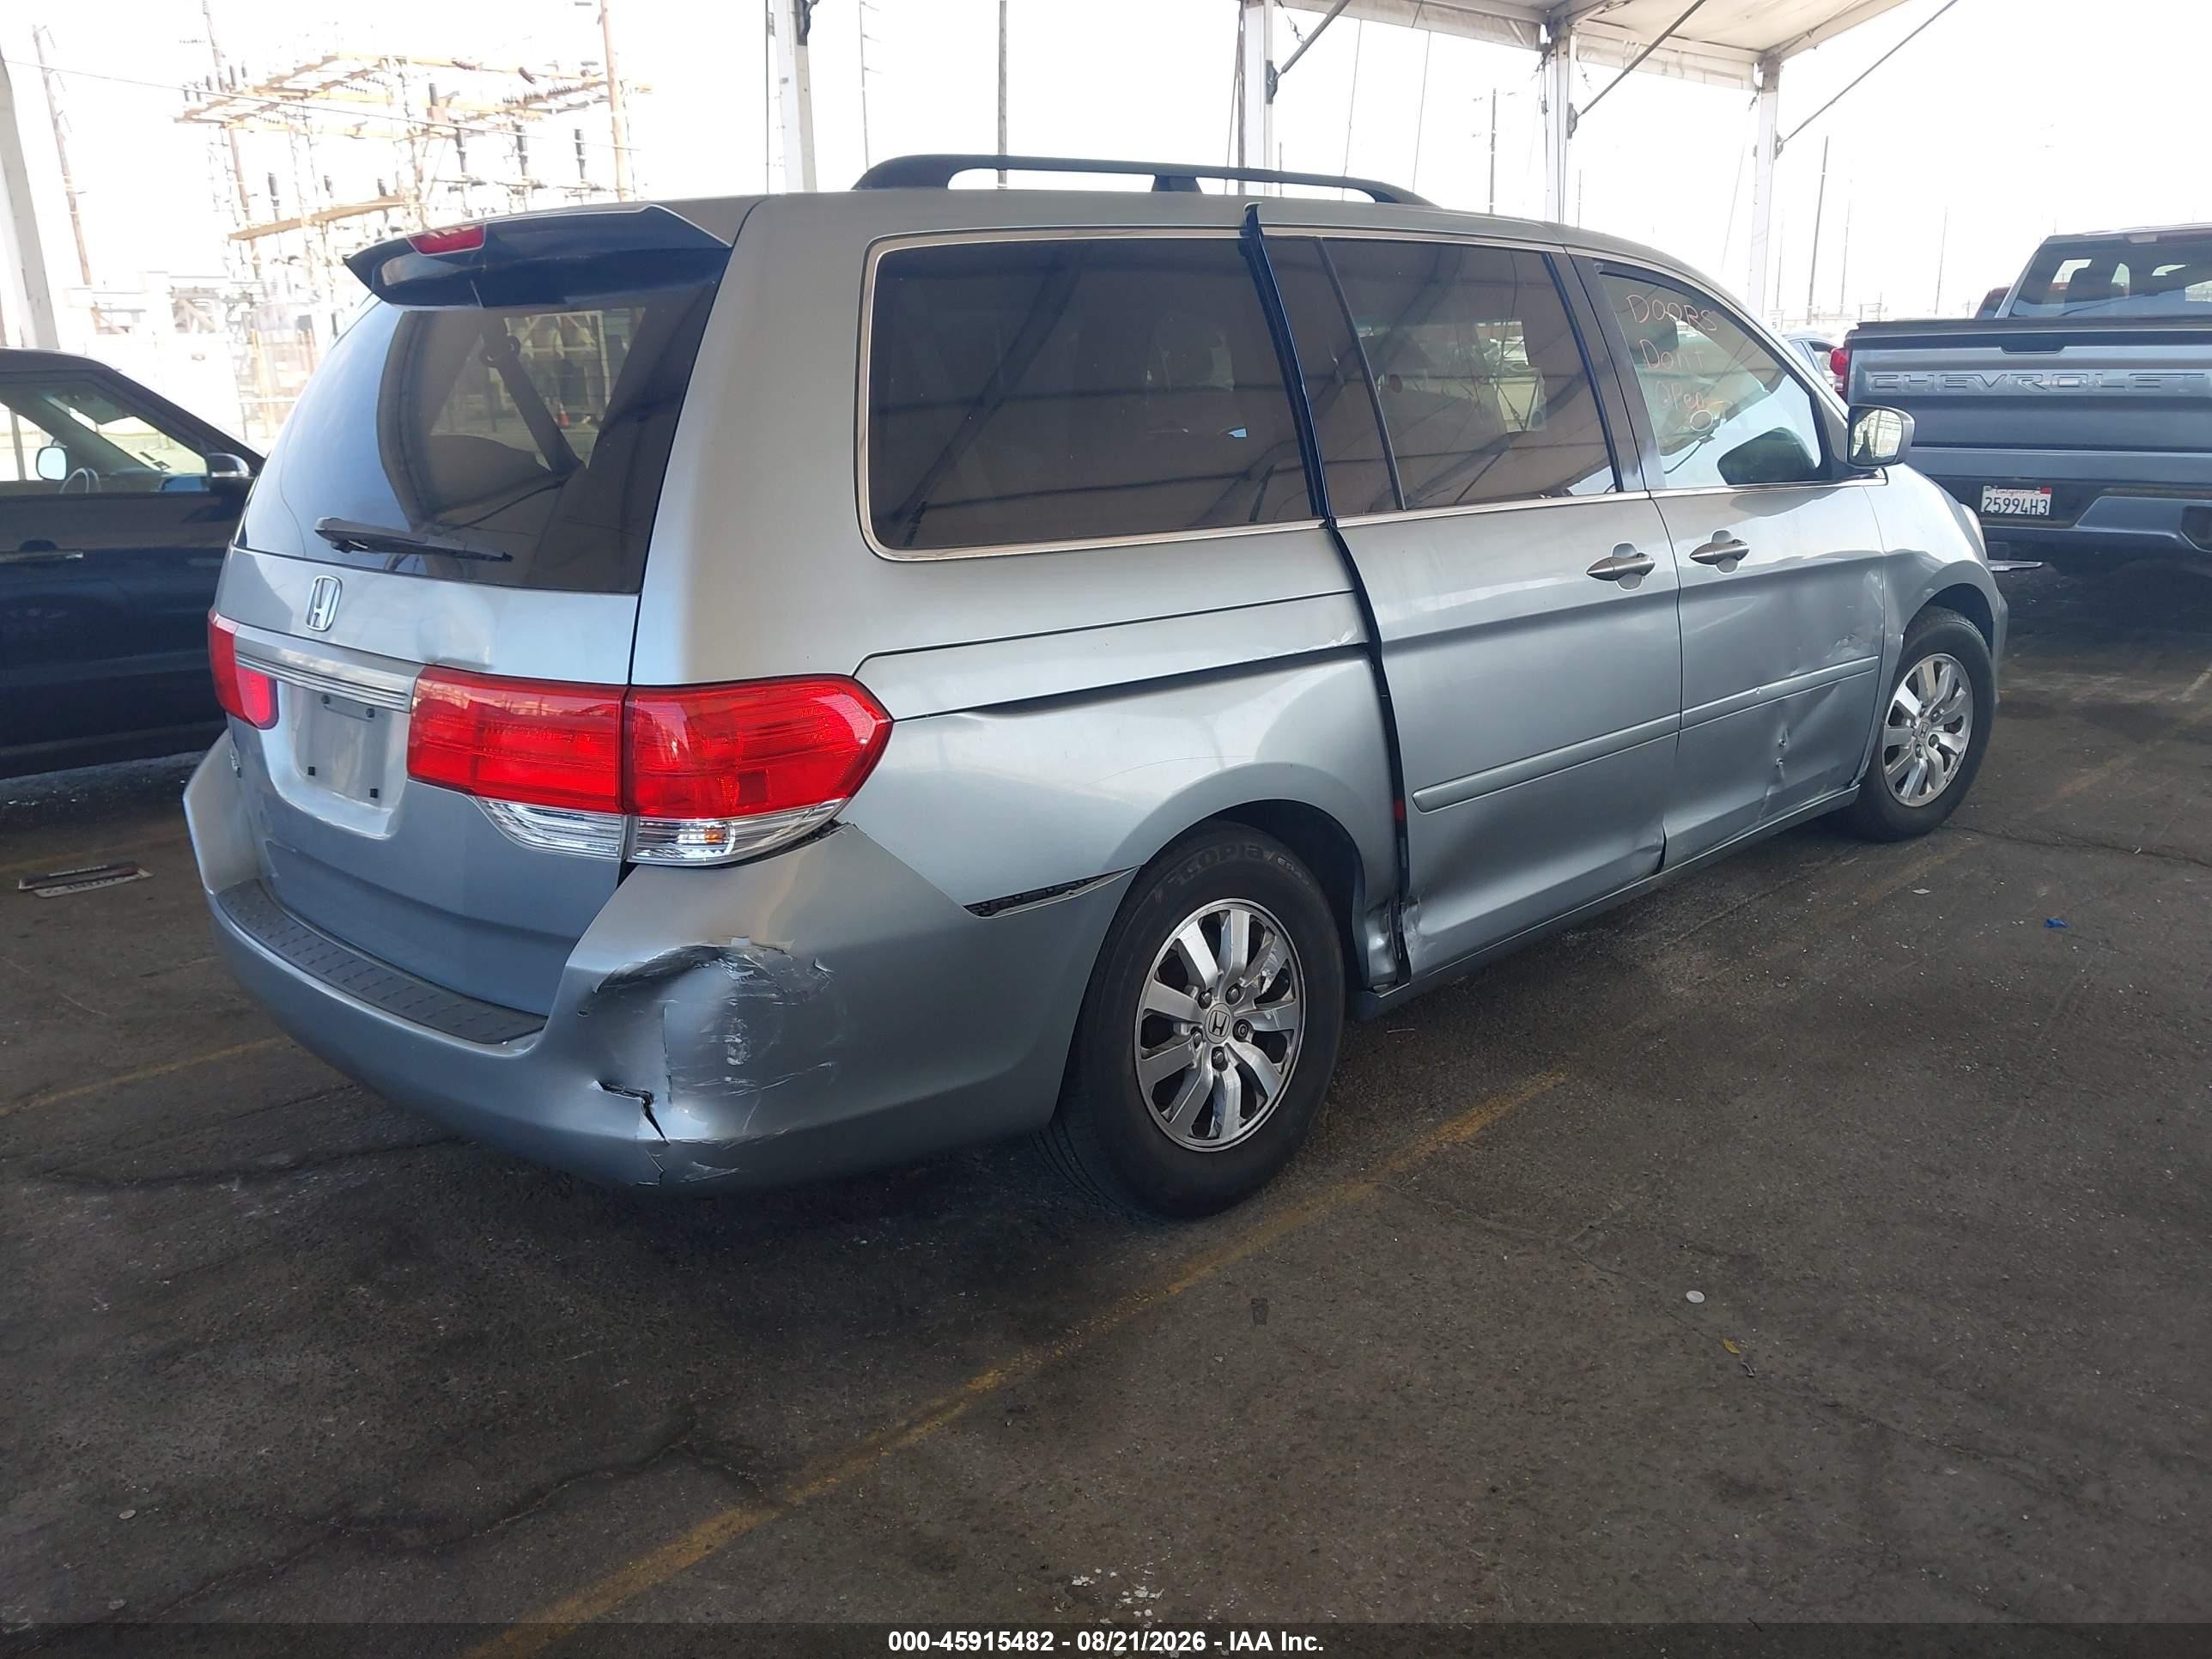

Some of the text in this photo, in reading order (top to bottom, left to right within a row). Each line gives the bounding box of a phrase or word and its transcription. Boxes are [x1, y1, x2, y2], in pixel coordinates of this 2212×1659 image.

[1626, 294, 1717, 331] DOORS
[1868, 372, 2207, 392] CHEVROLET
[1984, 496, 2048, 515] 25994H3
